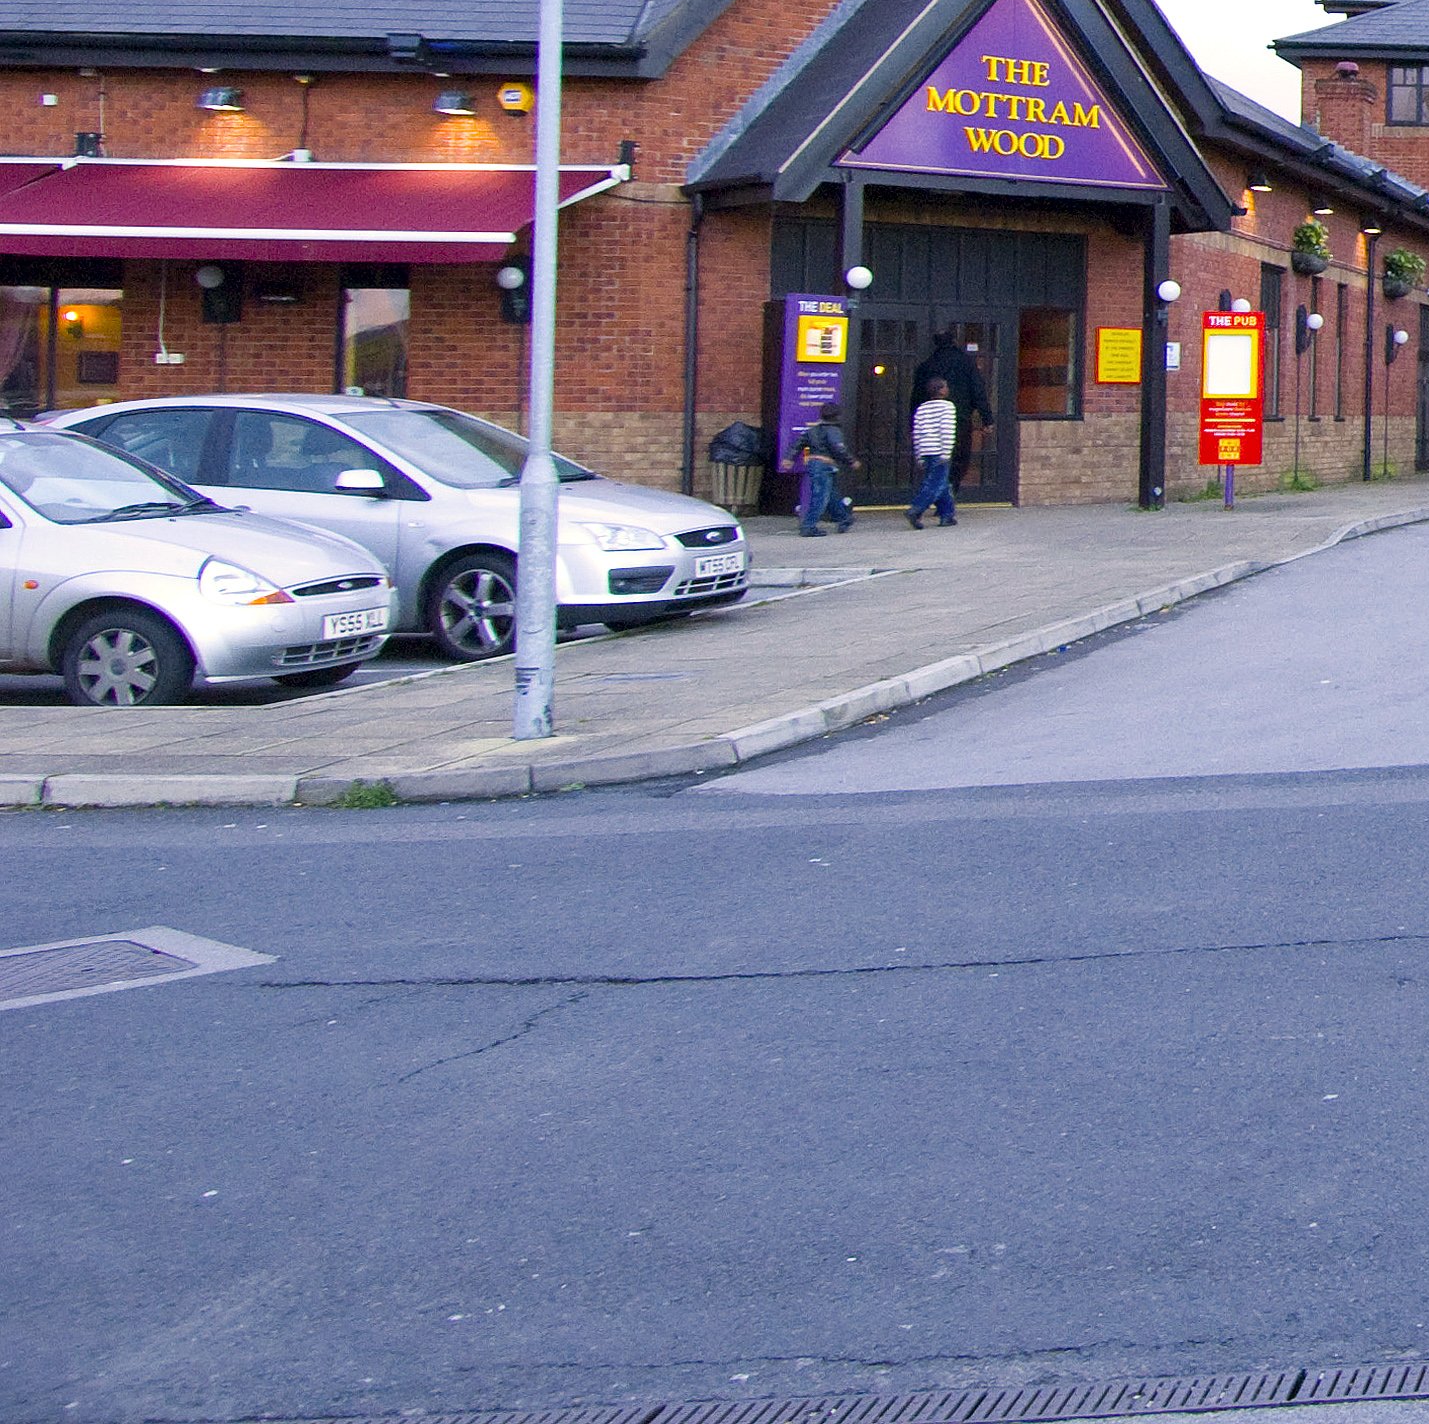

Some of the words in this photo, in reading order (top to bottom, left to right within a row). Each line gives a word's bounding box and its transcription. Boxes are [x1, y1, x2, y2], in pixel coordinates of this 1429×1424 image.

[981, 55, 1050, 87] THE
[926, 86, 1101, 129] MOTTRAM
[963, 126, 1065, 160] WOOD
[798, 301, 818, 313] THE
[819, 302, 844, 314] DEAL
[1209, 316, 1232, 326] THE
[1234, 316, 1257, 326] PUB
